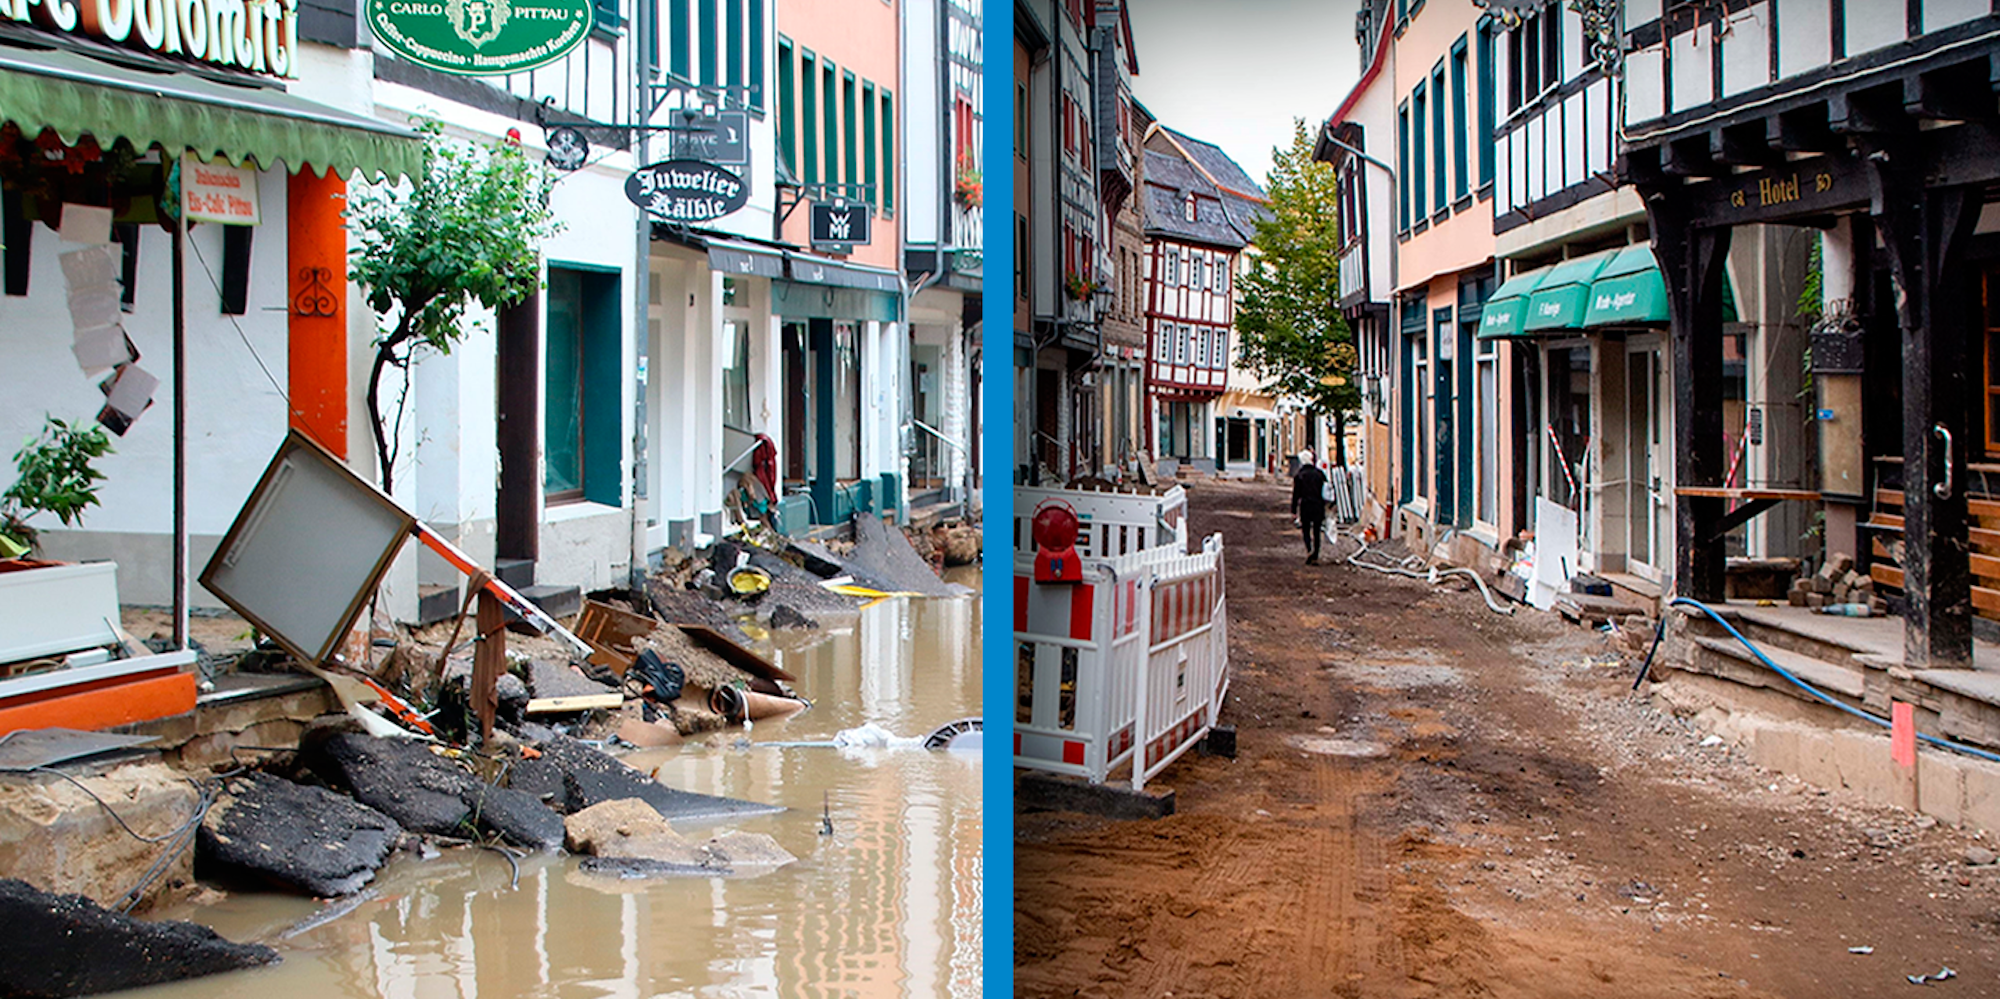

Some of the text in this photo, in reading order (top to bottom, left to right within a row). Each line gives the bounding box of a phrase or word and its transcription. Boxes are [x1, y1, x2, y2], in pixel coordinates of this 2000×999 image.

[390, 1, 569, 20] CARLO PITTAU
[546, 20, 582, 53] Kuchen
[635, 169, 741, 199] Juwelier
[1759, 172, 1801, 206] Hotel
[644, 191, 727, 219] Kälble
